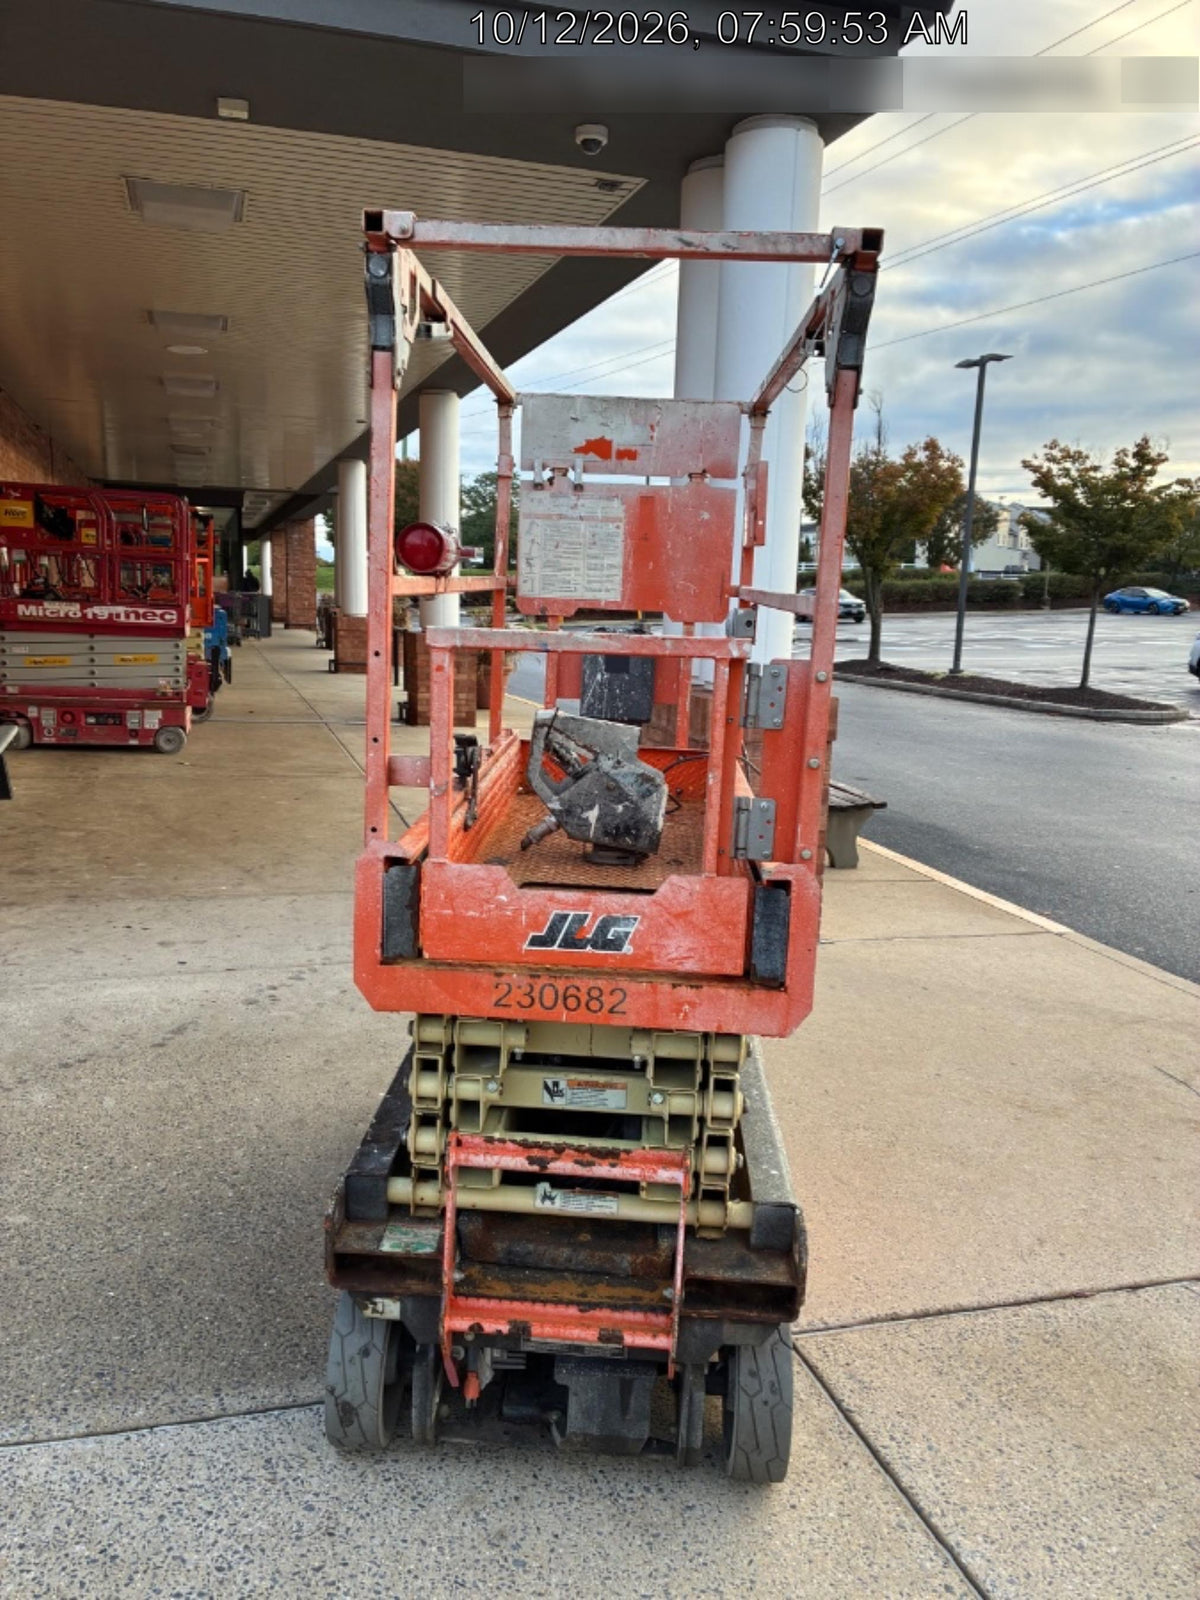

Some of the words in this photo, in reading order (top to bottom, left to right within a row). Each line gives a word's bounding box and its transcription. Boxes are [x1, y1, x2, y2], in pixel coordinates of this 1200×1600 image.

[17, 604, 82, 618] Micro
[523, 910, 641, 954] JLG
[493, 982, 628, 1015] 230682
